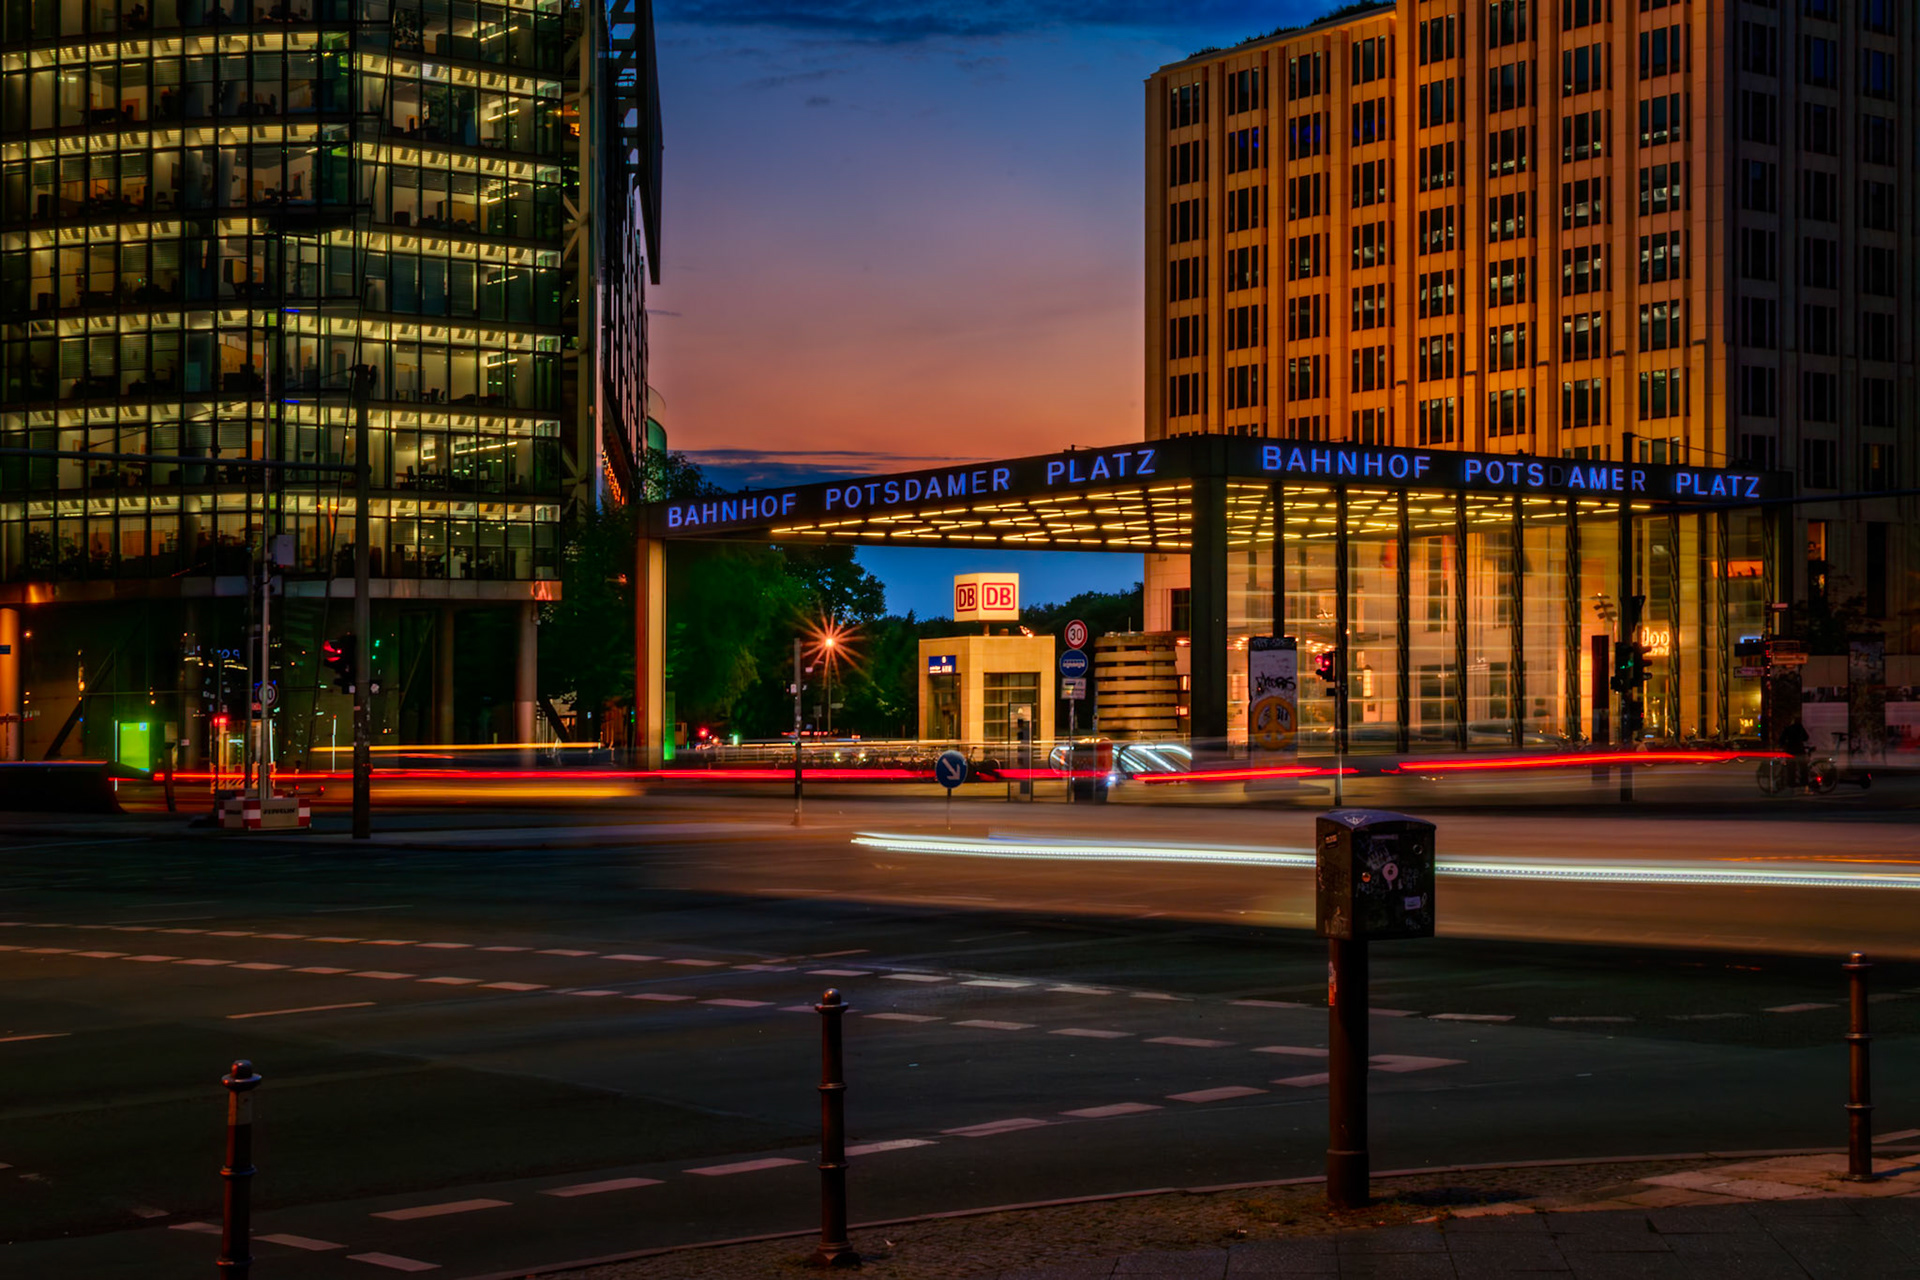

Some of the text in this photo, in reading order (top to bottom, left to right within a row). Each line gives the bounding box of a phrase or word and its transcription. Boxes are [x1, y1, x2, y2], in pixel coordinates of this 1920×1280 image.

[1262, 445, 1760, 498] BAHNHOF POTSDAMER PLATZ
[669, 449, 1156, 528] BAHNHOF POTSDAMER PLATZ
[958, 588, 975, 608] DB
[986, 587, 1012, 606] DB
[1070, 628, 1083, 641] 30
